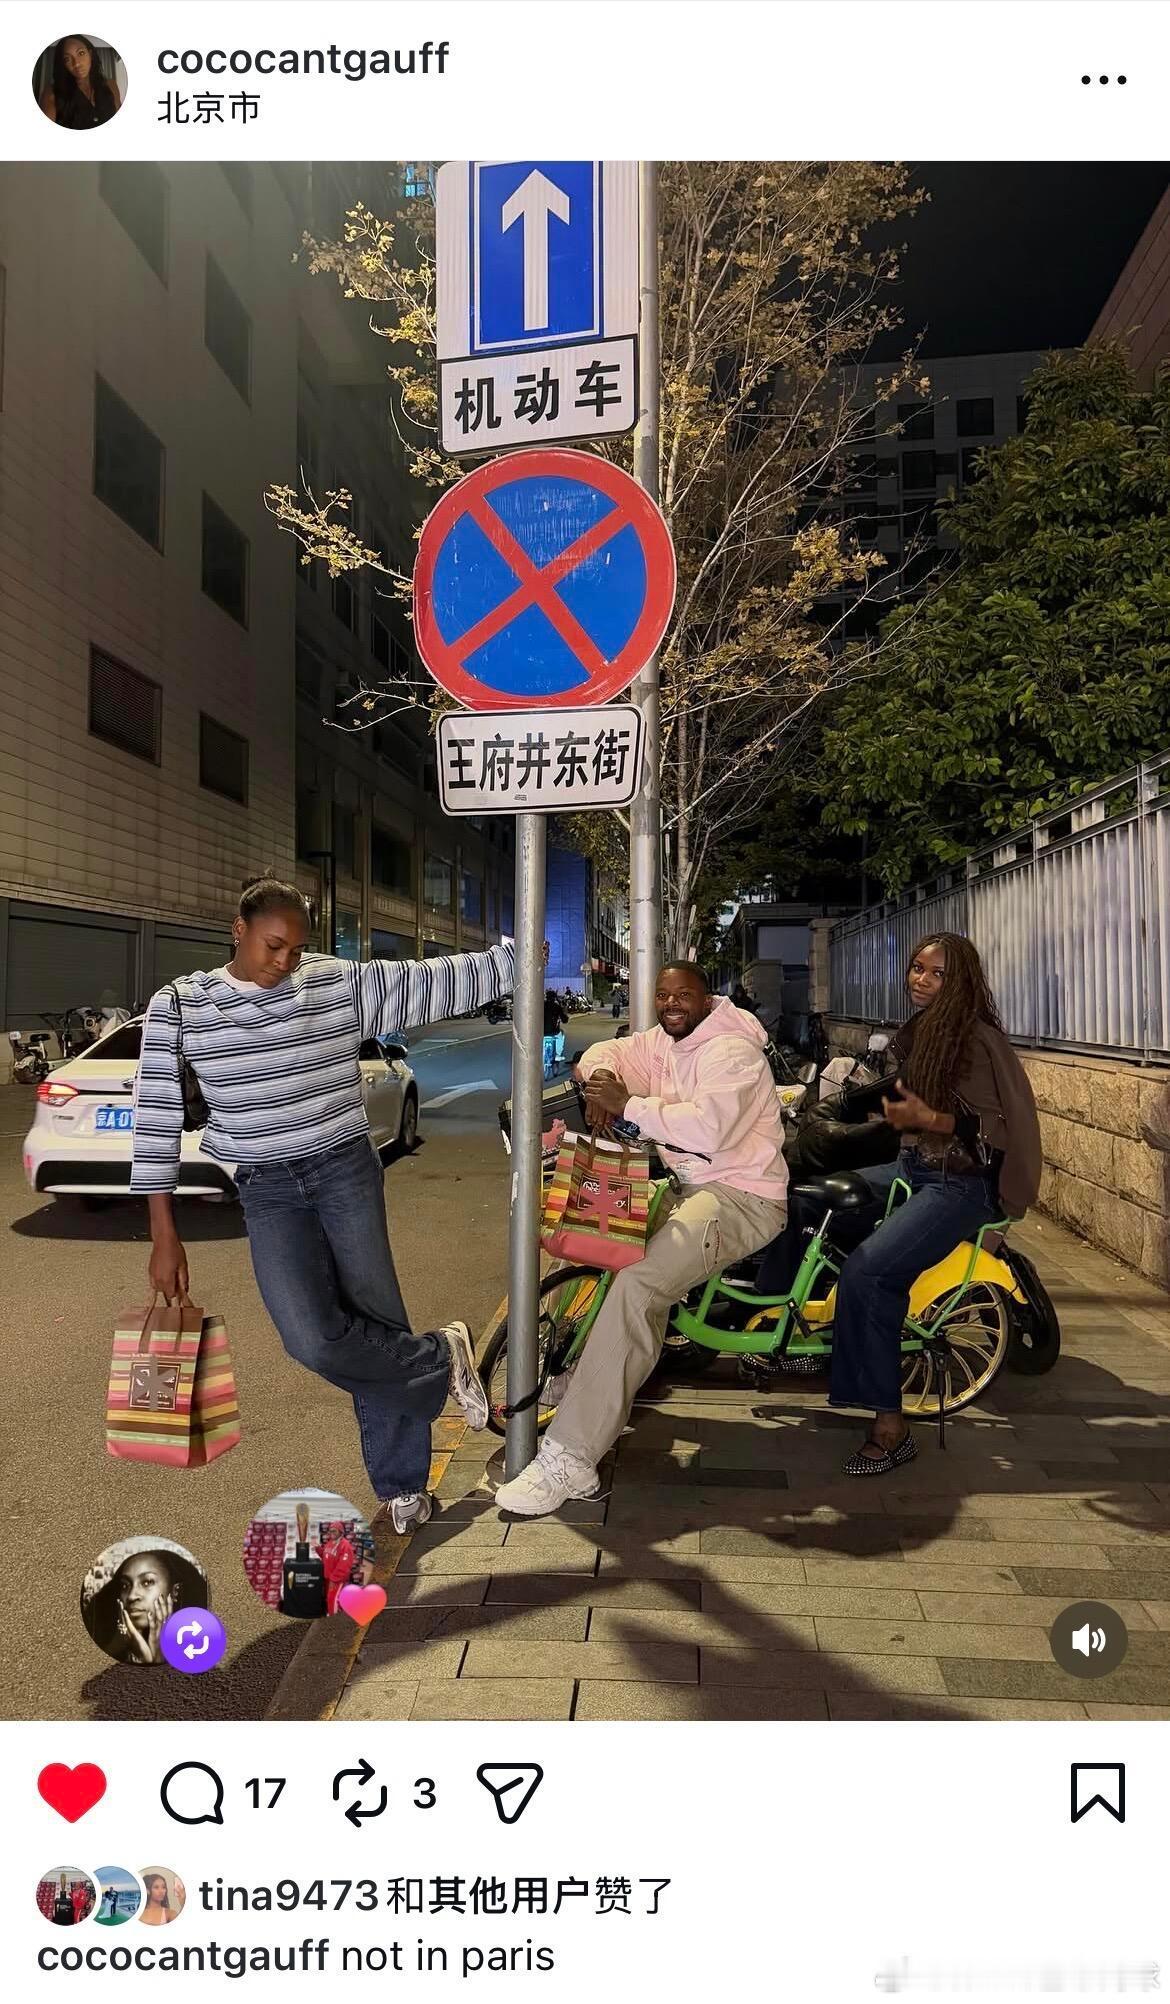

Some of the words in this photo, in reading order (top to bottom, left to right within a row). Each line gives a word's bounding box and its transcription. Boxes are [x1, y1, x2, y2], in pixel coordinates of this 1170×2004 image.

[454, 360, 622, 435] 机动车
[447, 728, 631, 792] 王府井东街
